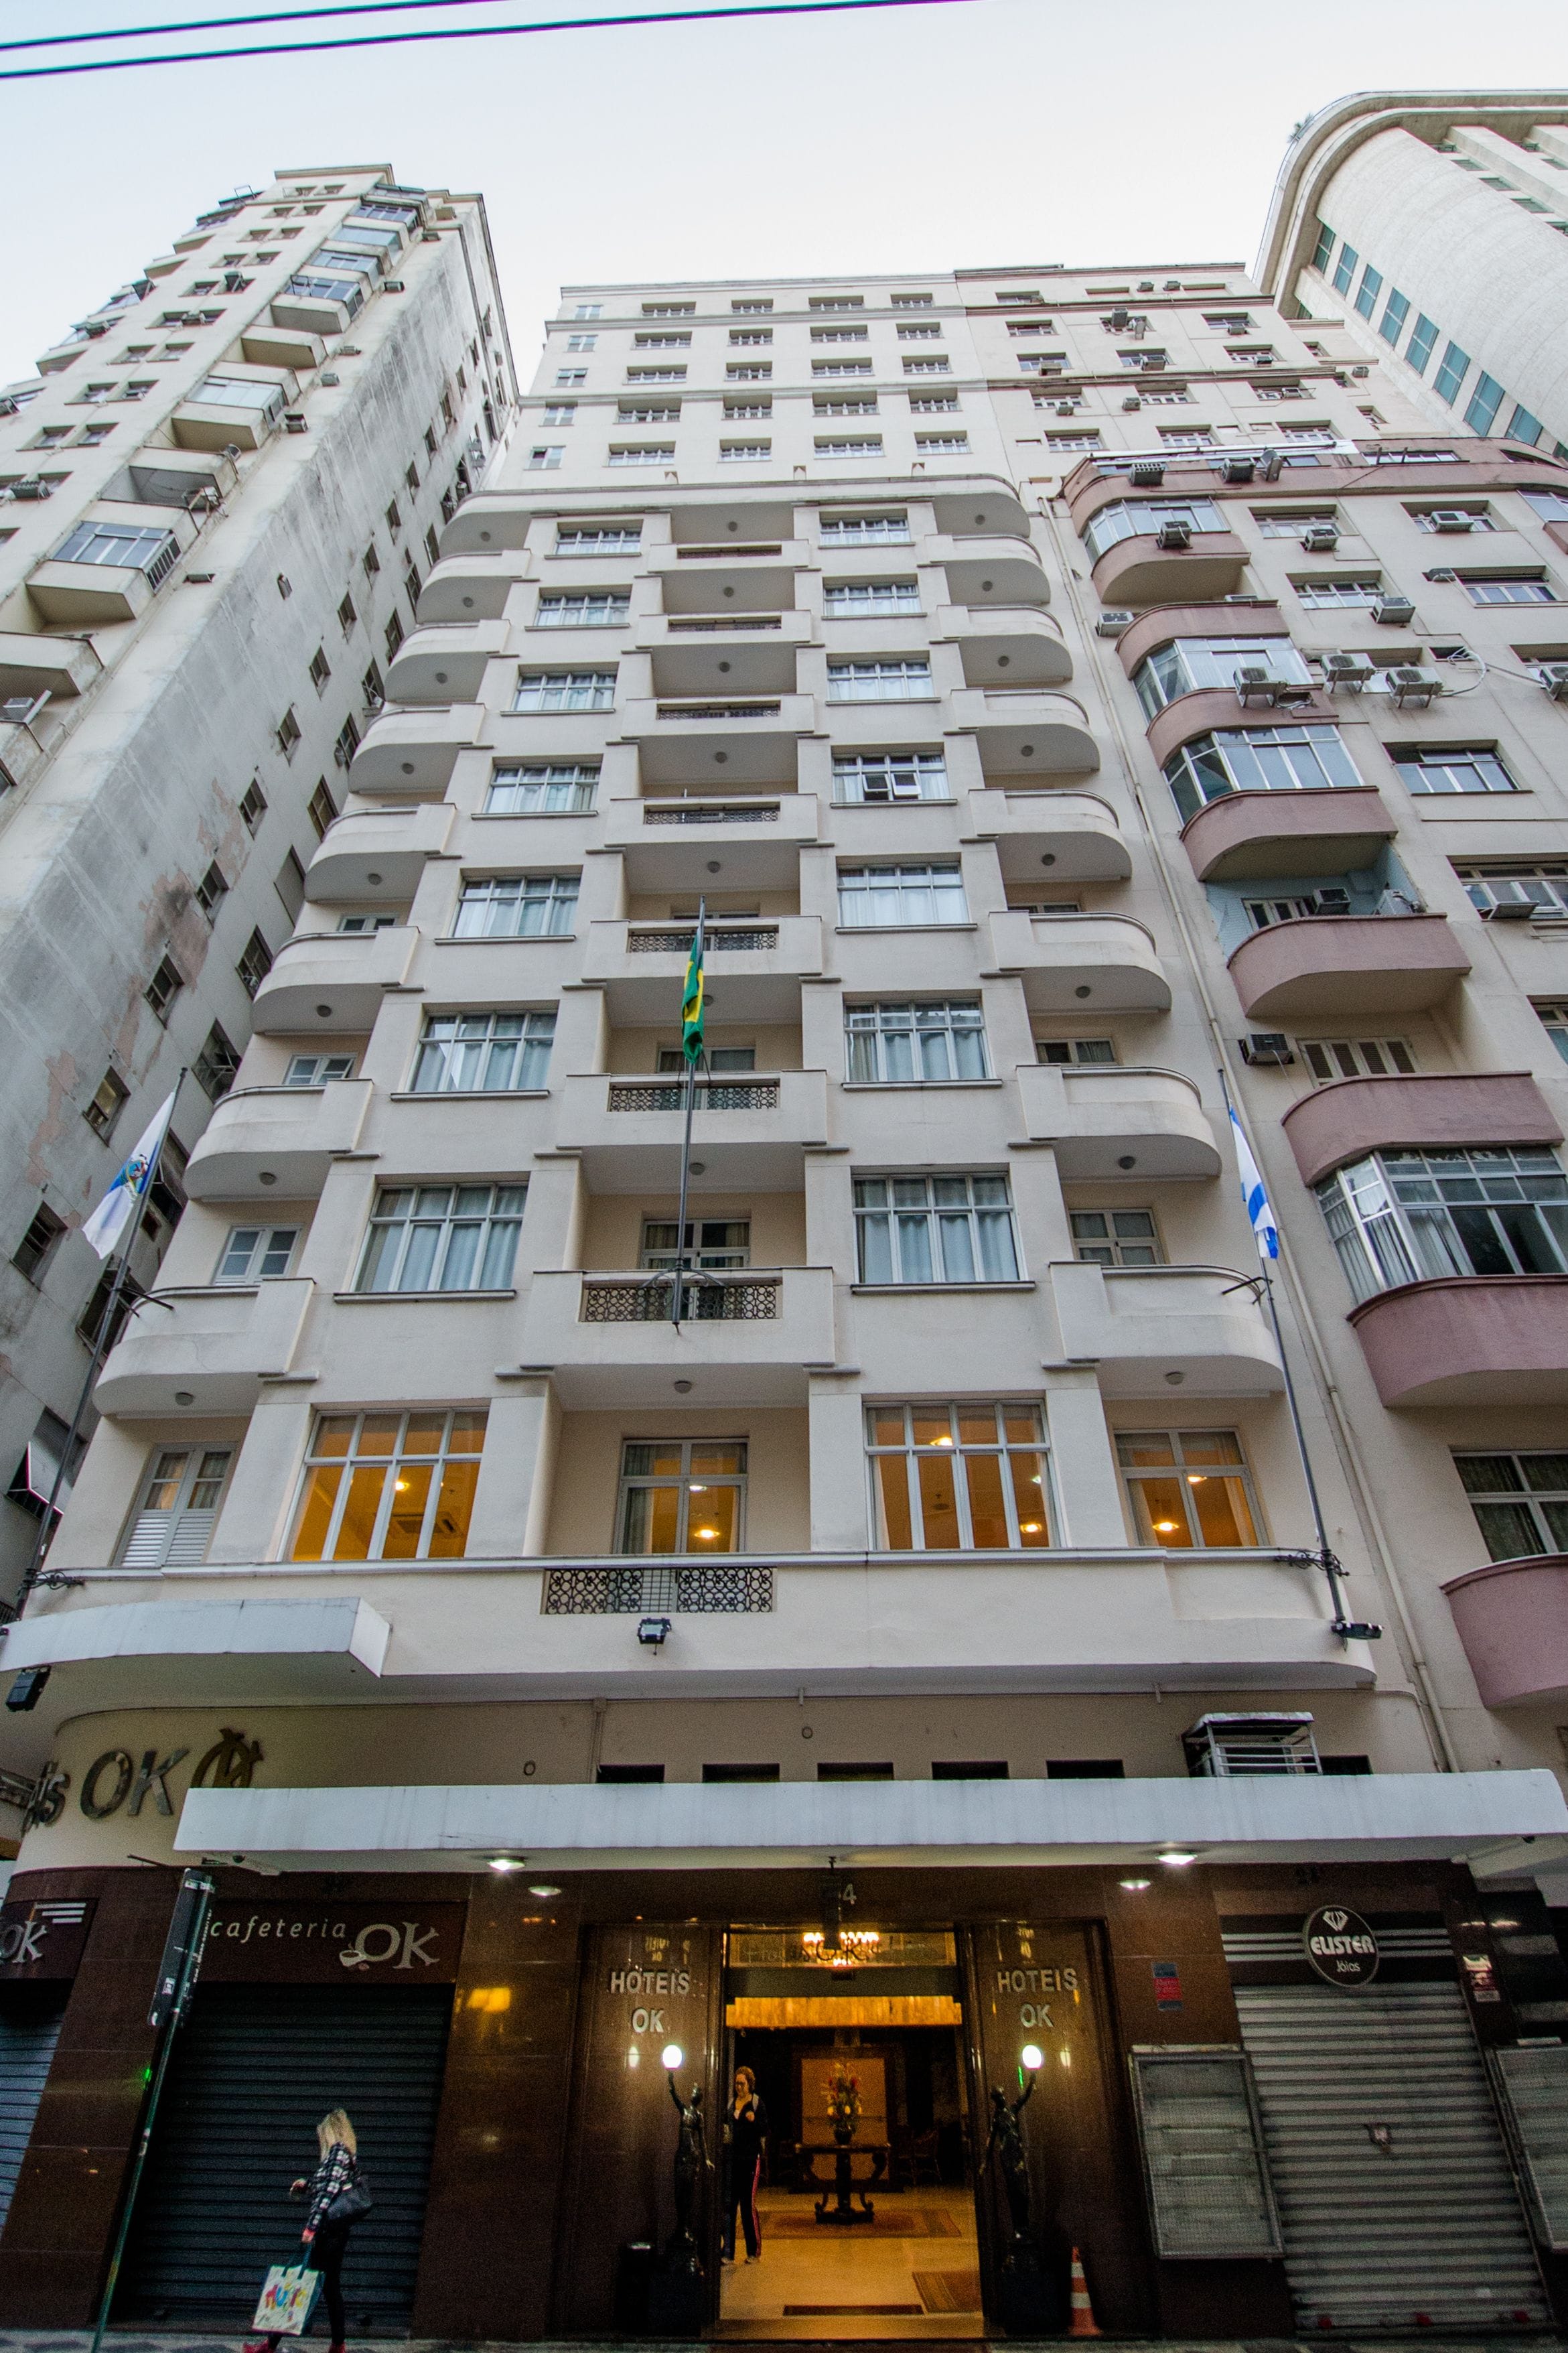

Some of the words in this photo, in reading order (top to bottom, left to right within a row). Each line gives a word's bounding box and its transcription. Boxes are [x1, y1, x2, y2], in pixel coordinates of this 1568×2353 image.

[80, 1748, 190, 1820] OK
[210, 1915, 346, 1944] cafeteria
[354, 1922, 440, 1969] OK
[632, 2008, 664, 2033] OK
[1020, 2003, 1054, 2028] OK
